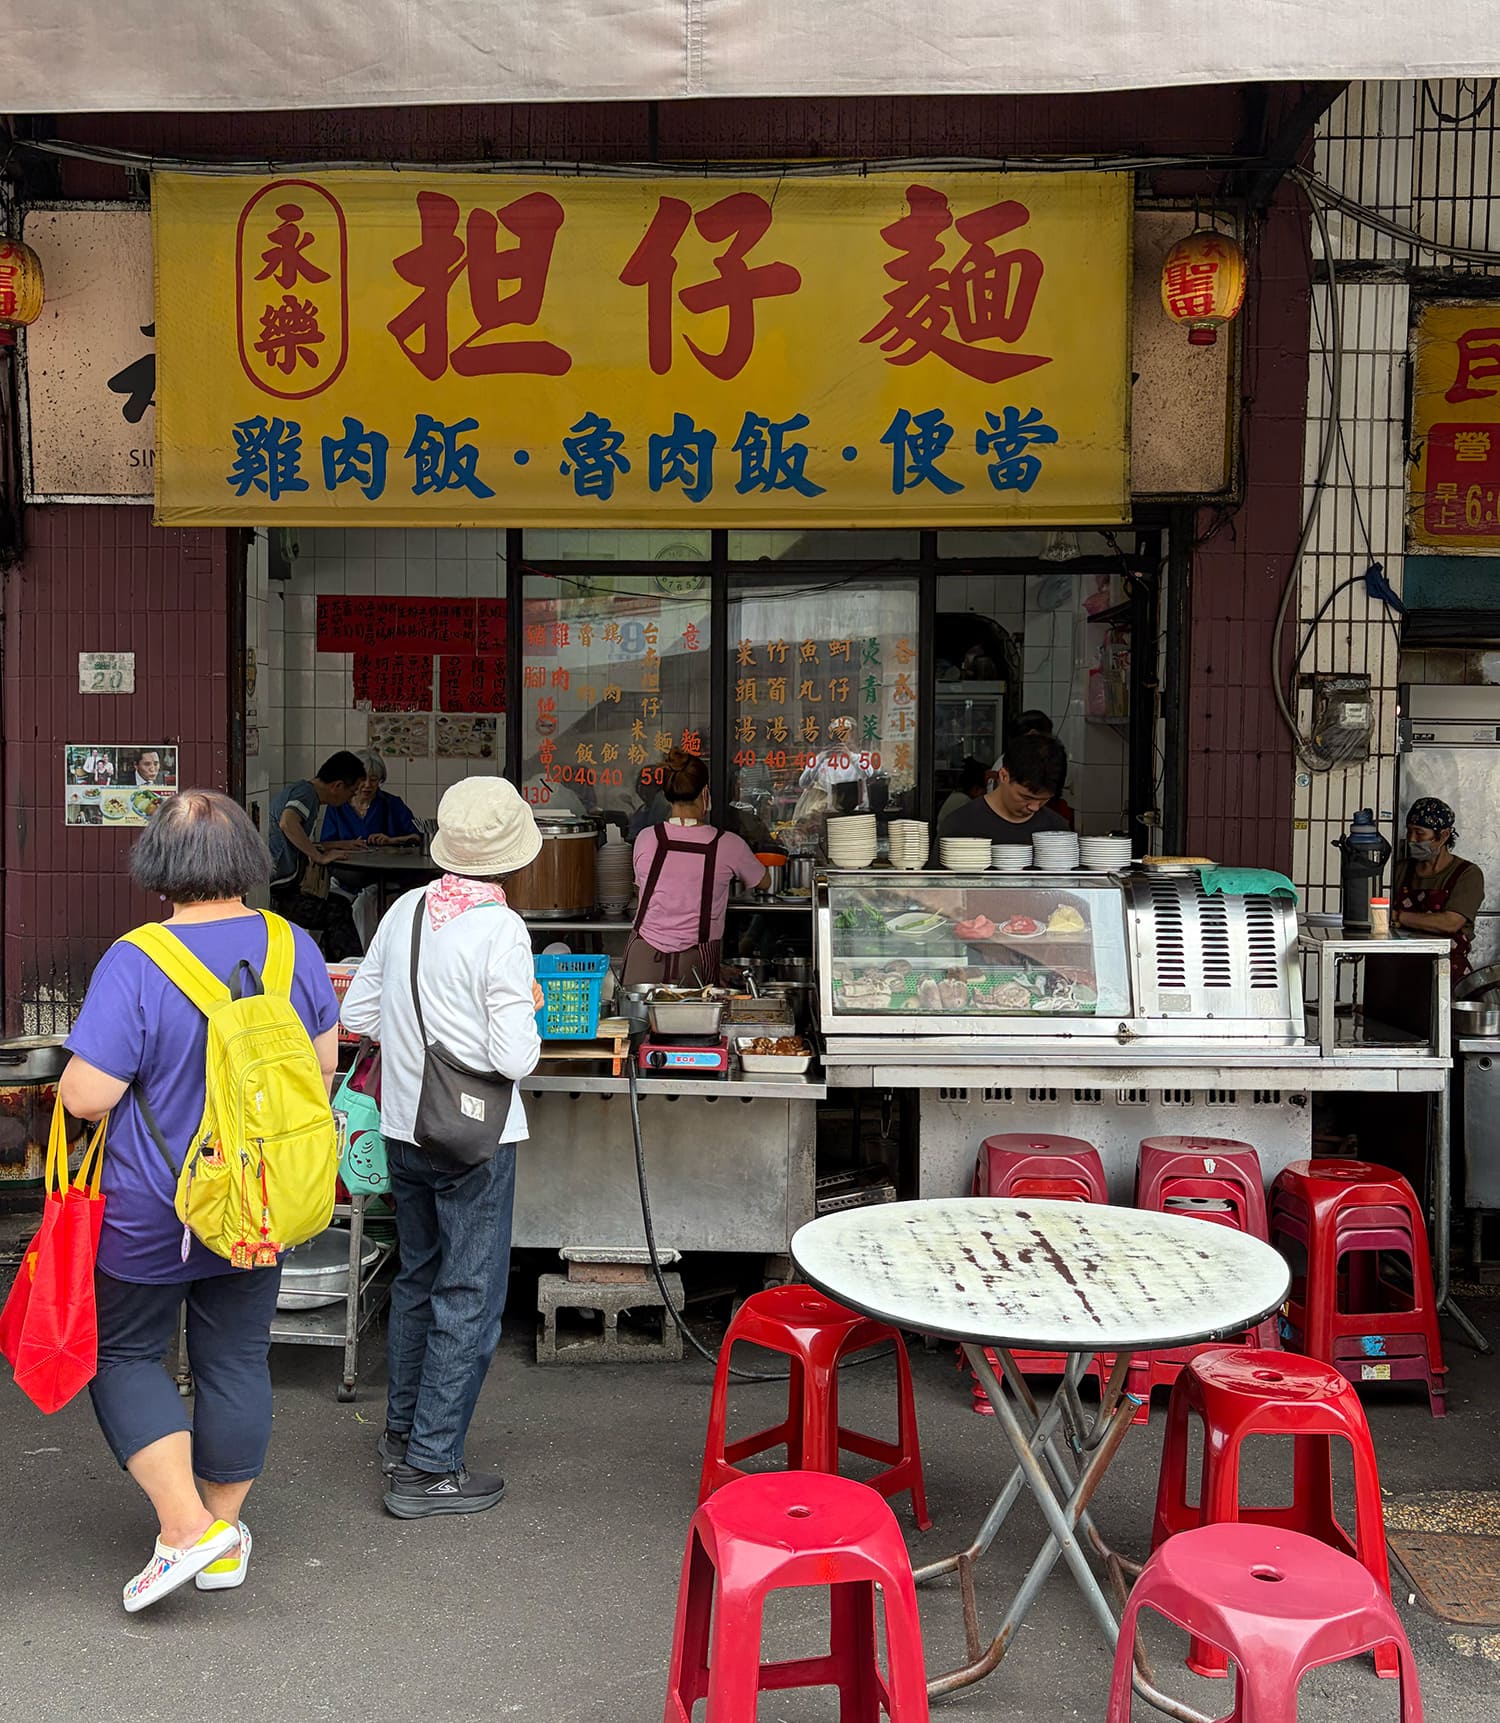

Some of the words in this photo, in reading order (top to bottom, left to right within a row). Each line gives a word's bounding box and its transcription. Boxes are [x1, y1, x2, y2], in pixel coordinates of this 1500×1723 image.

[254, 204, 332, 375] 永樂
[387, 184, 1053, 384] 担仔麵
[1465, 484, 1500, 528] 6:
[735, 638, 758, 743] 菜頭湯
[766, 638, 790, 743] 竹筍湯
[798, 638, 821, 743] 魚丸湯
[828, 638, 851, 743] 蚵仔湯
[733, 750, 755, 768] 40
[763, 751, 786, 769] 40
[794, 751, 817, 769] 40
[827, 752, 850, 770] 40
[859, 752, 881, 770] 50
[545, 765, 573, 783] 120
[574, 768, 598, 785] 40
[600, 769, 623, 786] 40
[641, 767, 664, 785] 50
